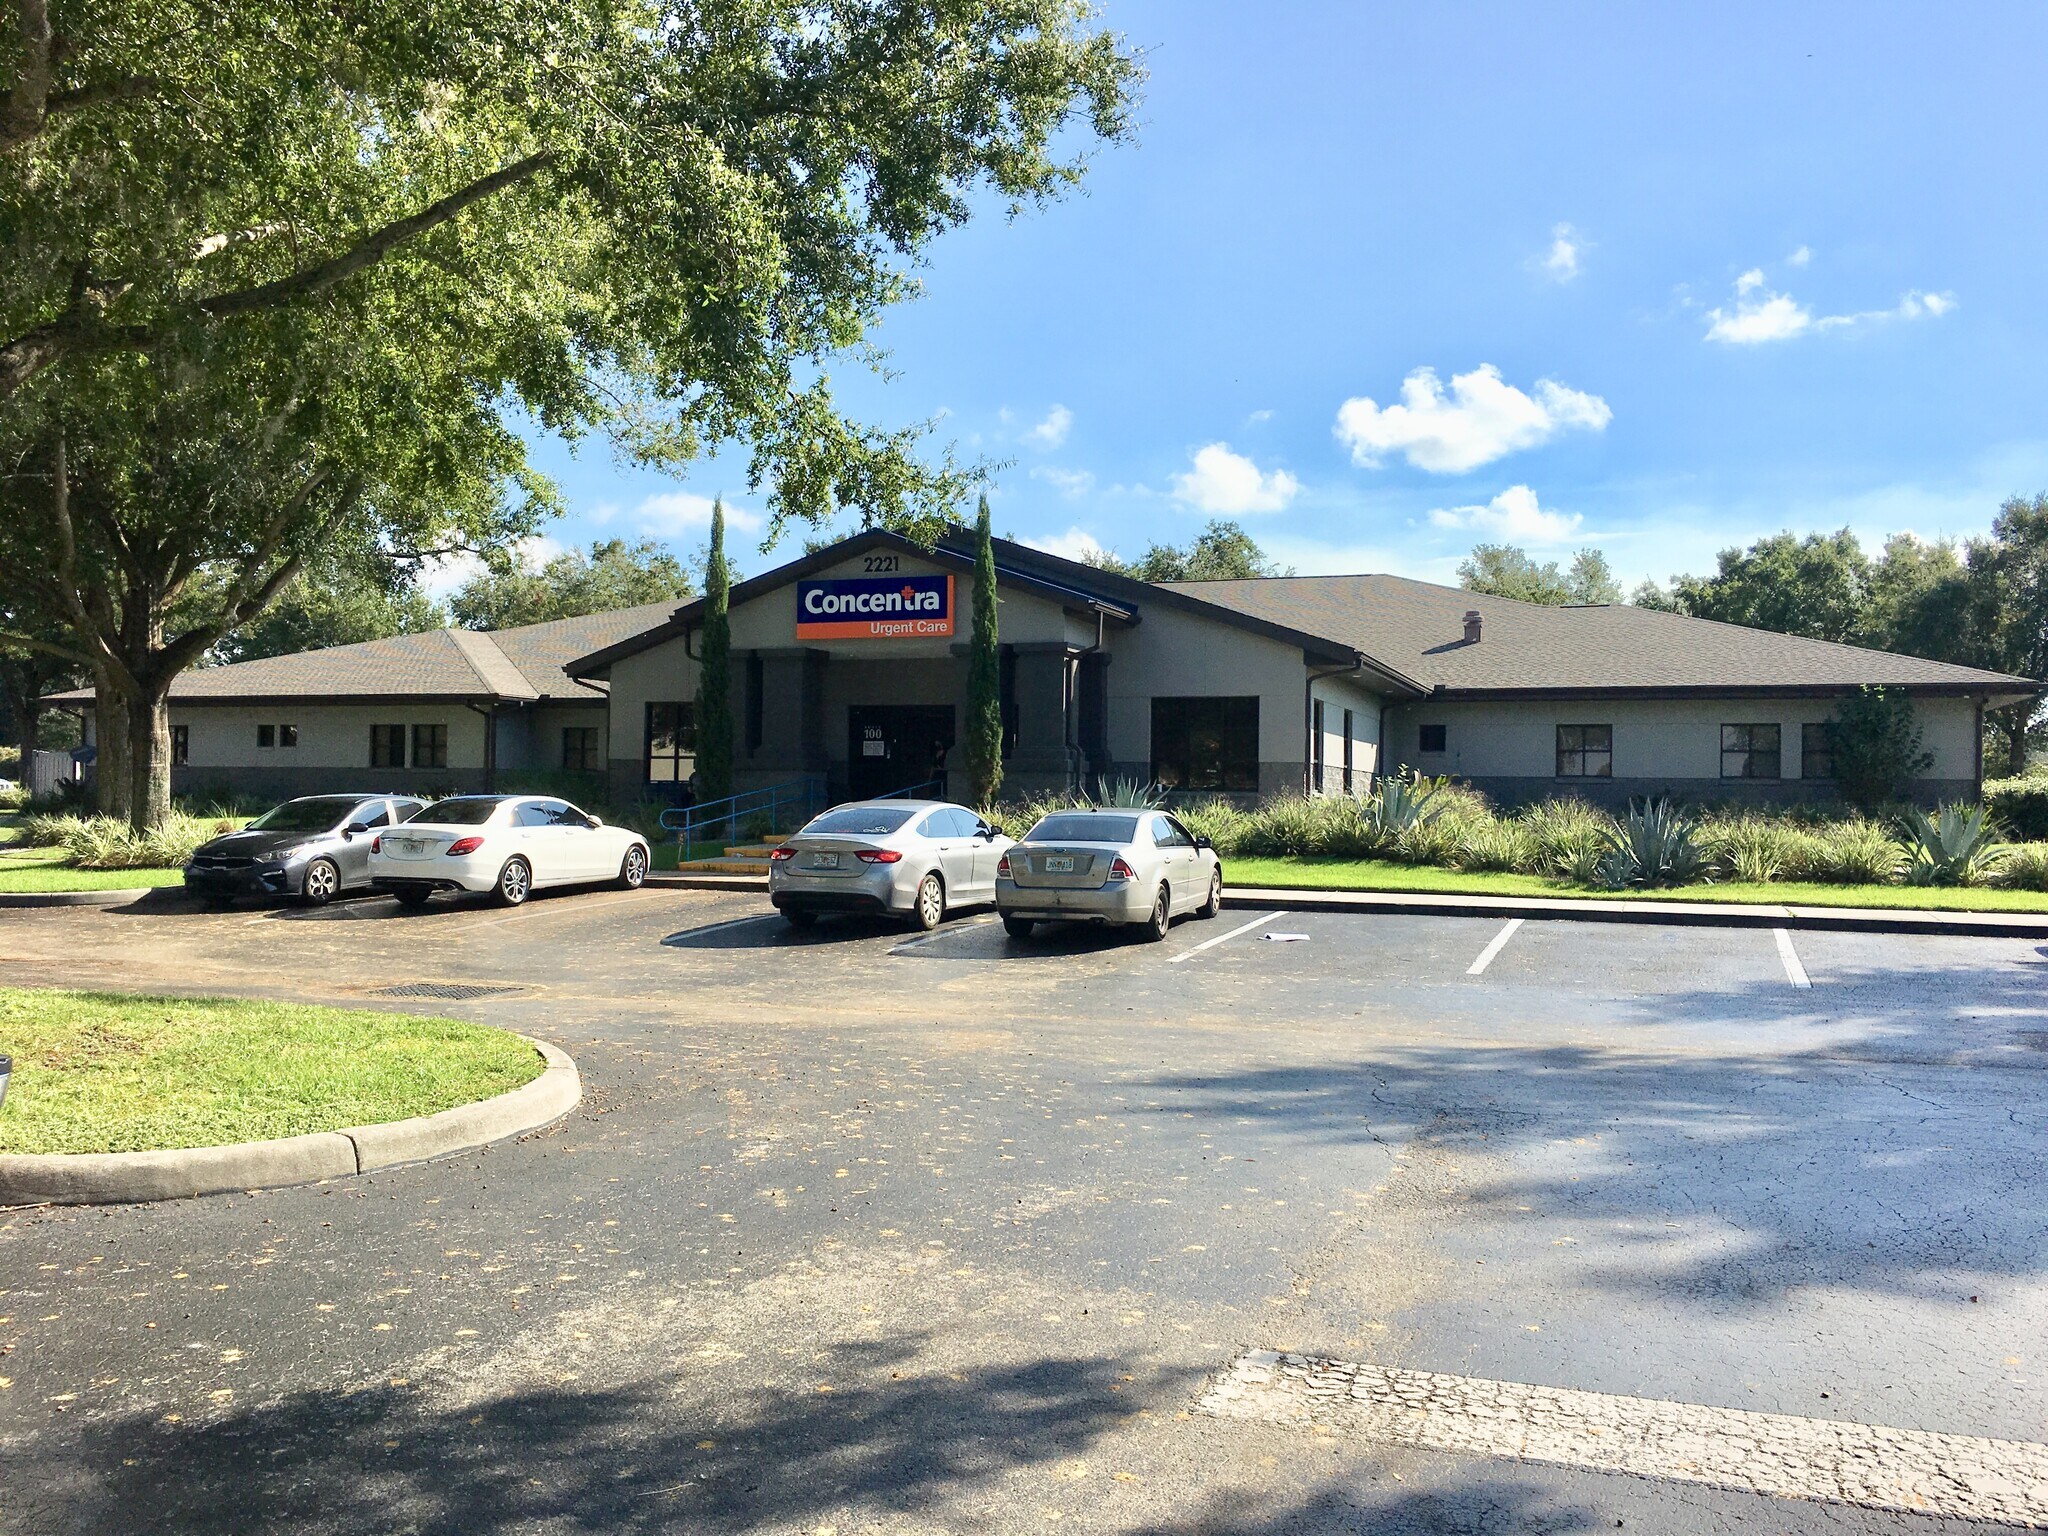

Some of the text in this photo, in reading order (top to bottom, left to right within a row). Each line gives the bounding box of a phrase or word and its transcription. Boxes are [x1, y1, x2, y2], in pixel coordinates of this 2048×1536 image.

[864, 556, 899, 573] 2221
[804, 585, 940, 615] Concentra
[870, 620, 948, 636] Urgent Care
[864, 729, 882, 739] 100
